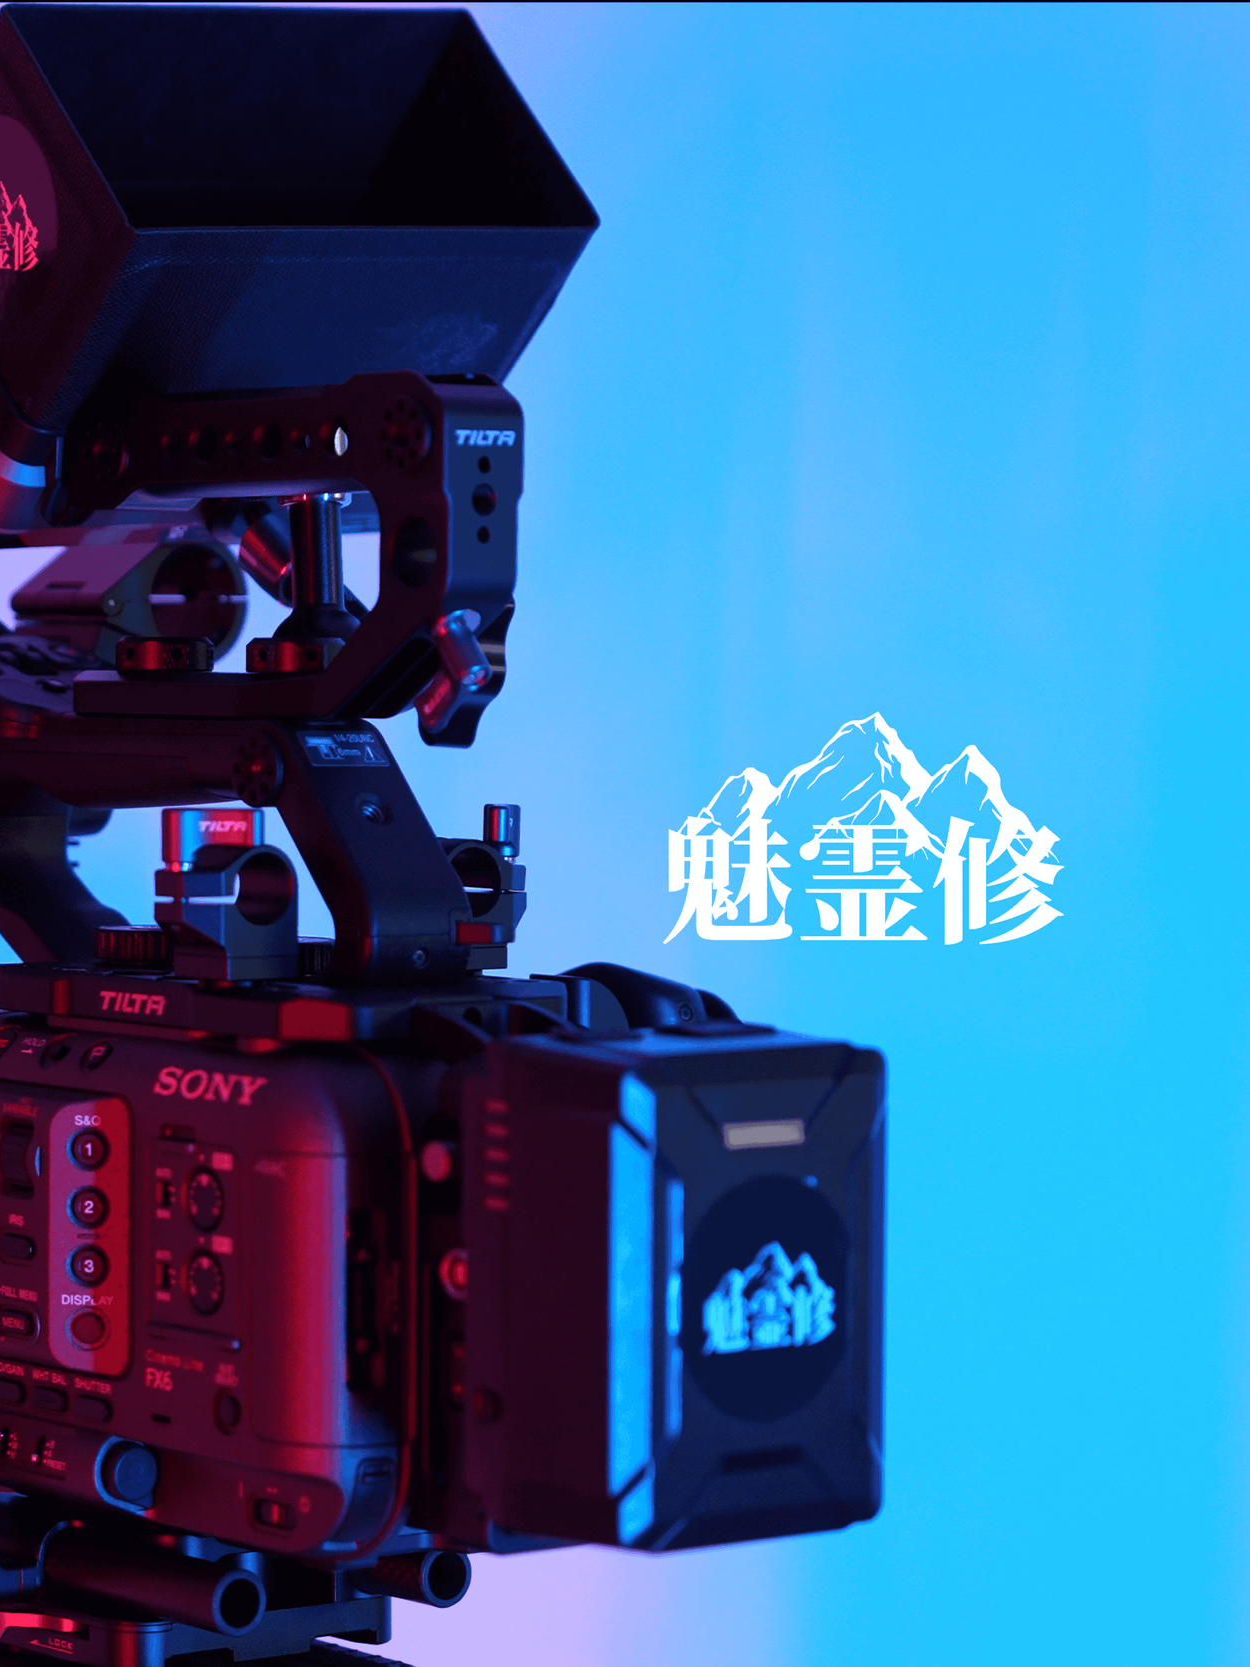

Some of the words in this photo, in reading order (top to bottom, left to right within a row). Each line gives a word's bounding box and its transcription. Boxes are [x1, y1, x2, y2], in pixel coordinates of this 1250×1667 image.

[454, 428, 517, 447] TILTA
[197, 819, 249, 834] TILTA
[99, 989, 167, 1016] TILTA
[153, 1065, 268, 1106] SONY
[85, 1142, 93, 1157] 1
[84, 1200, 95, 1214] 2
[83, 1259, 95, 1273] 3
[61, 1293, 114, 1306] DISPLAY
[73, 1376, 112, 1395] SHUTTER
[145, 1366, 174, 1393] FX6
[48, 1637, 74, 1649] LOCK
